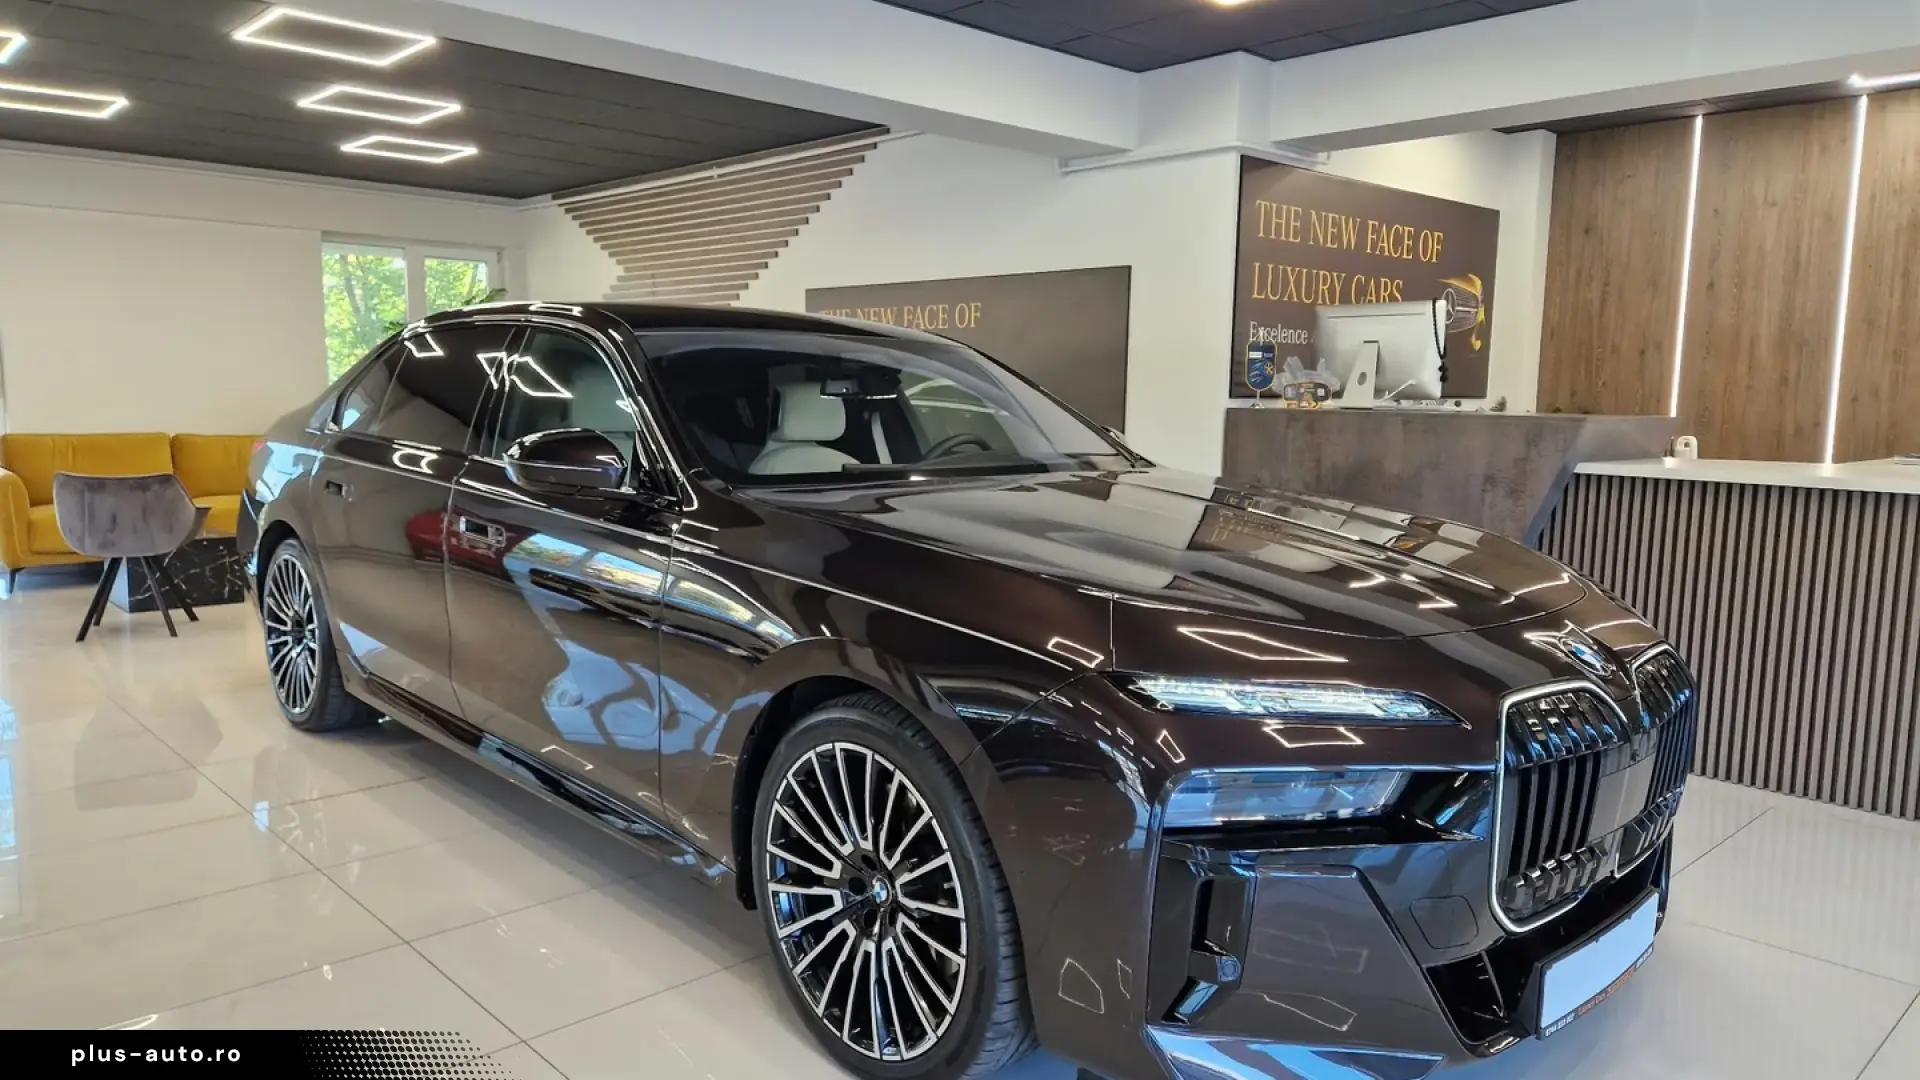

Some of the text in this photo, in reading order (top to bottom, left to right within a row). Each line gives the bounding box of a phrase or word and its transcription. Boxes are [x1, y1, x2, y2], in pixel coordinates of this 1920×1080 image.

[1255, 199, 1444, 264] THE NEW FACE OF
[1251, 262, 1404, 305] LUXURY CARS
[903, 304, 949, 330] FACE
[955, 302, 982, 329] OF
